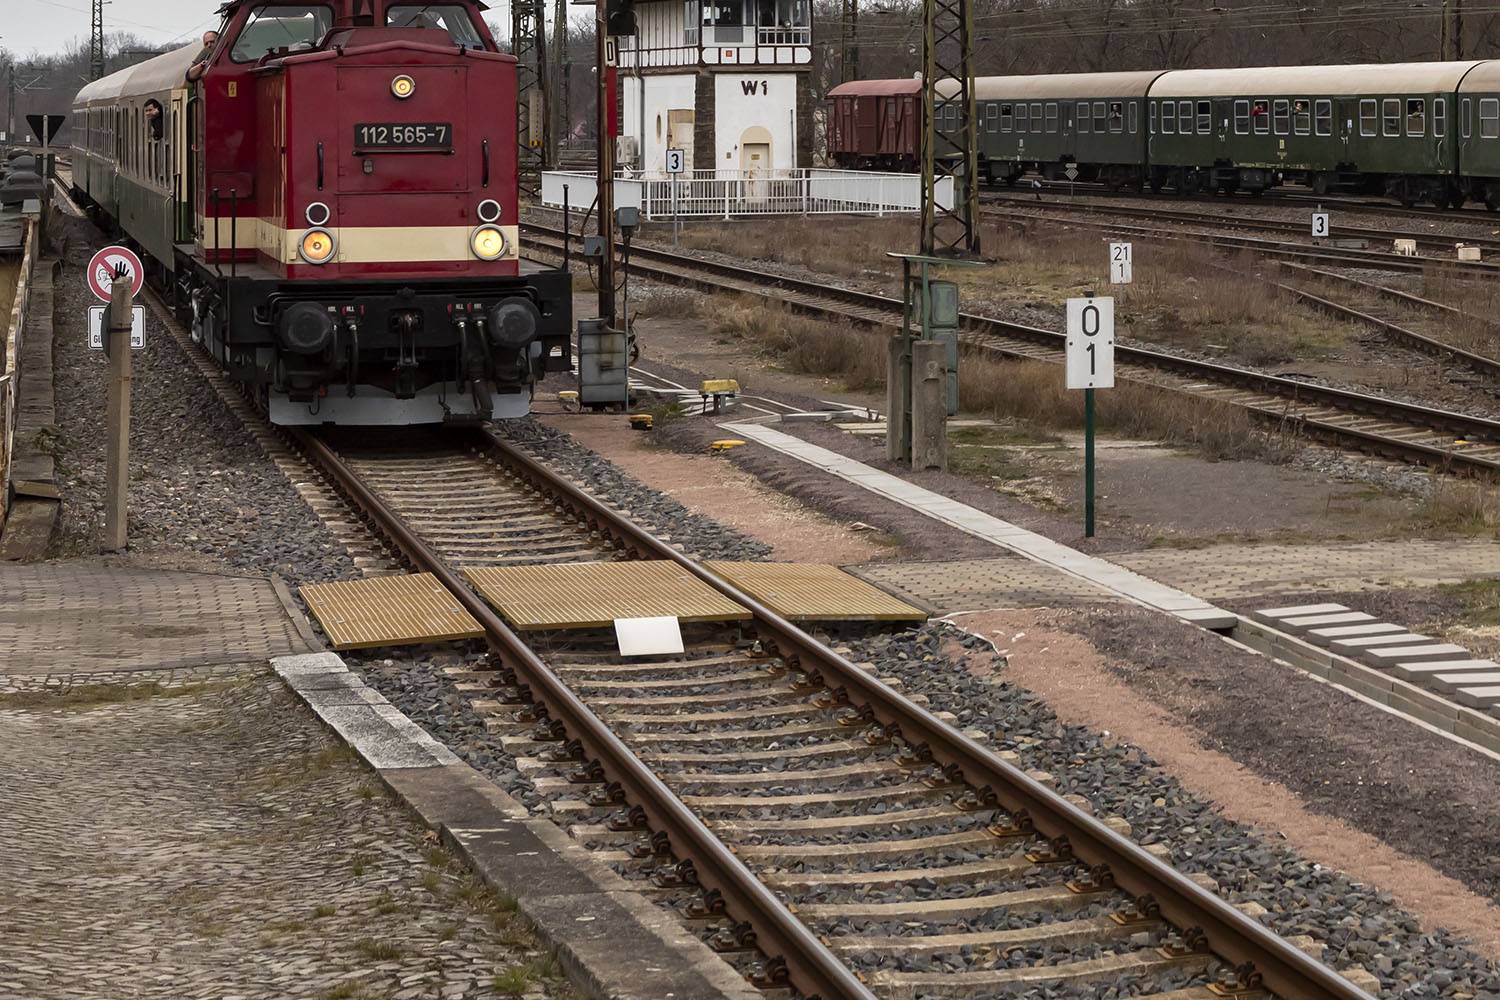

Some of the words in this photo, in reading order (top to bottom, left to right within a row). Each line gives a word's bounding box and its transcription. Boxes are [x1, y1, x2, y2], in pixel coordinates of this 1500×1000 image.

[361, 126, 388, 144] 112
[392, 126, 446, 143] 565-7
[671, 153, 679, 170] 3
[1316, 216, 1325, 233] 3
[1114, 246, 1128, 261] 21
[1119, 263, 1124, 278] 1
[1081, 305, 1100, 337] 0
[1086, 343, 1095, 375] 1
